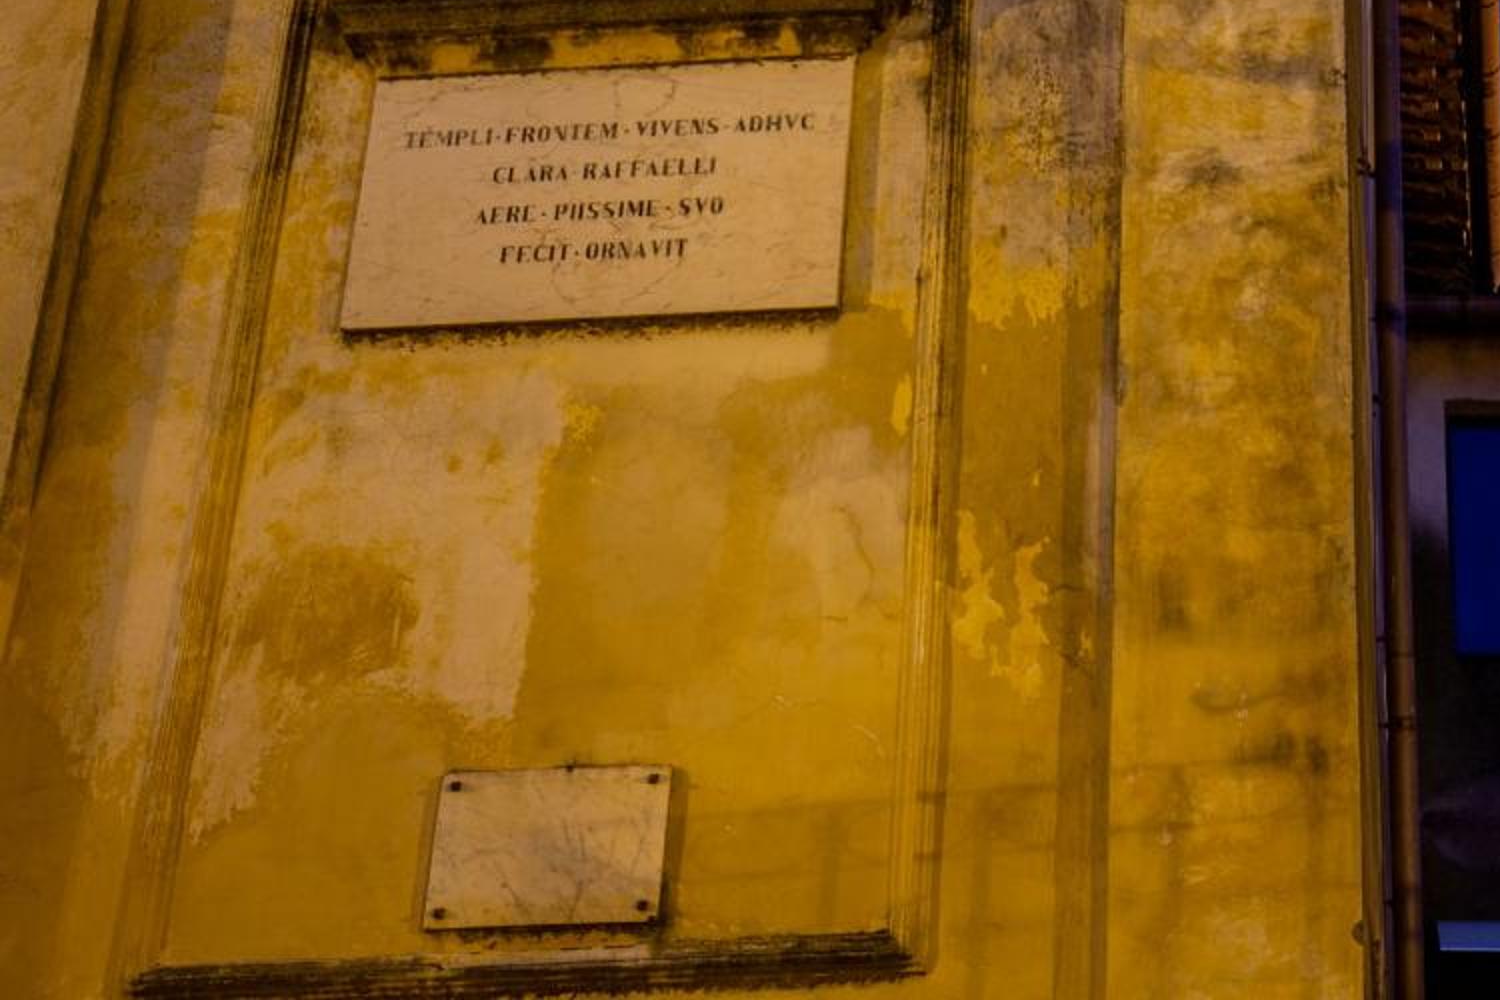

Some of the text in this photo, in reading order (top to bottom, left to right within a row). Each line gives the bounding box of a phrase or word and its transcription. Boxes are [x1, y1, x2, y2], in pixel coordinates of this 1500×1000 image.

[401, 113, 815, 149] TEMPLI FRONTEM VIVENS ADHVC
[492, 157, 717, 184] CLARA RAFFAELLI
[477, 197, 724, 225] AERE PIISSIME SVO
[499, 238, 688, 264] FECIT ORNAVIT
